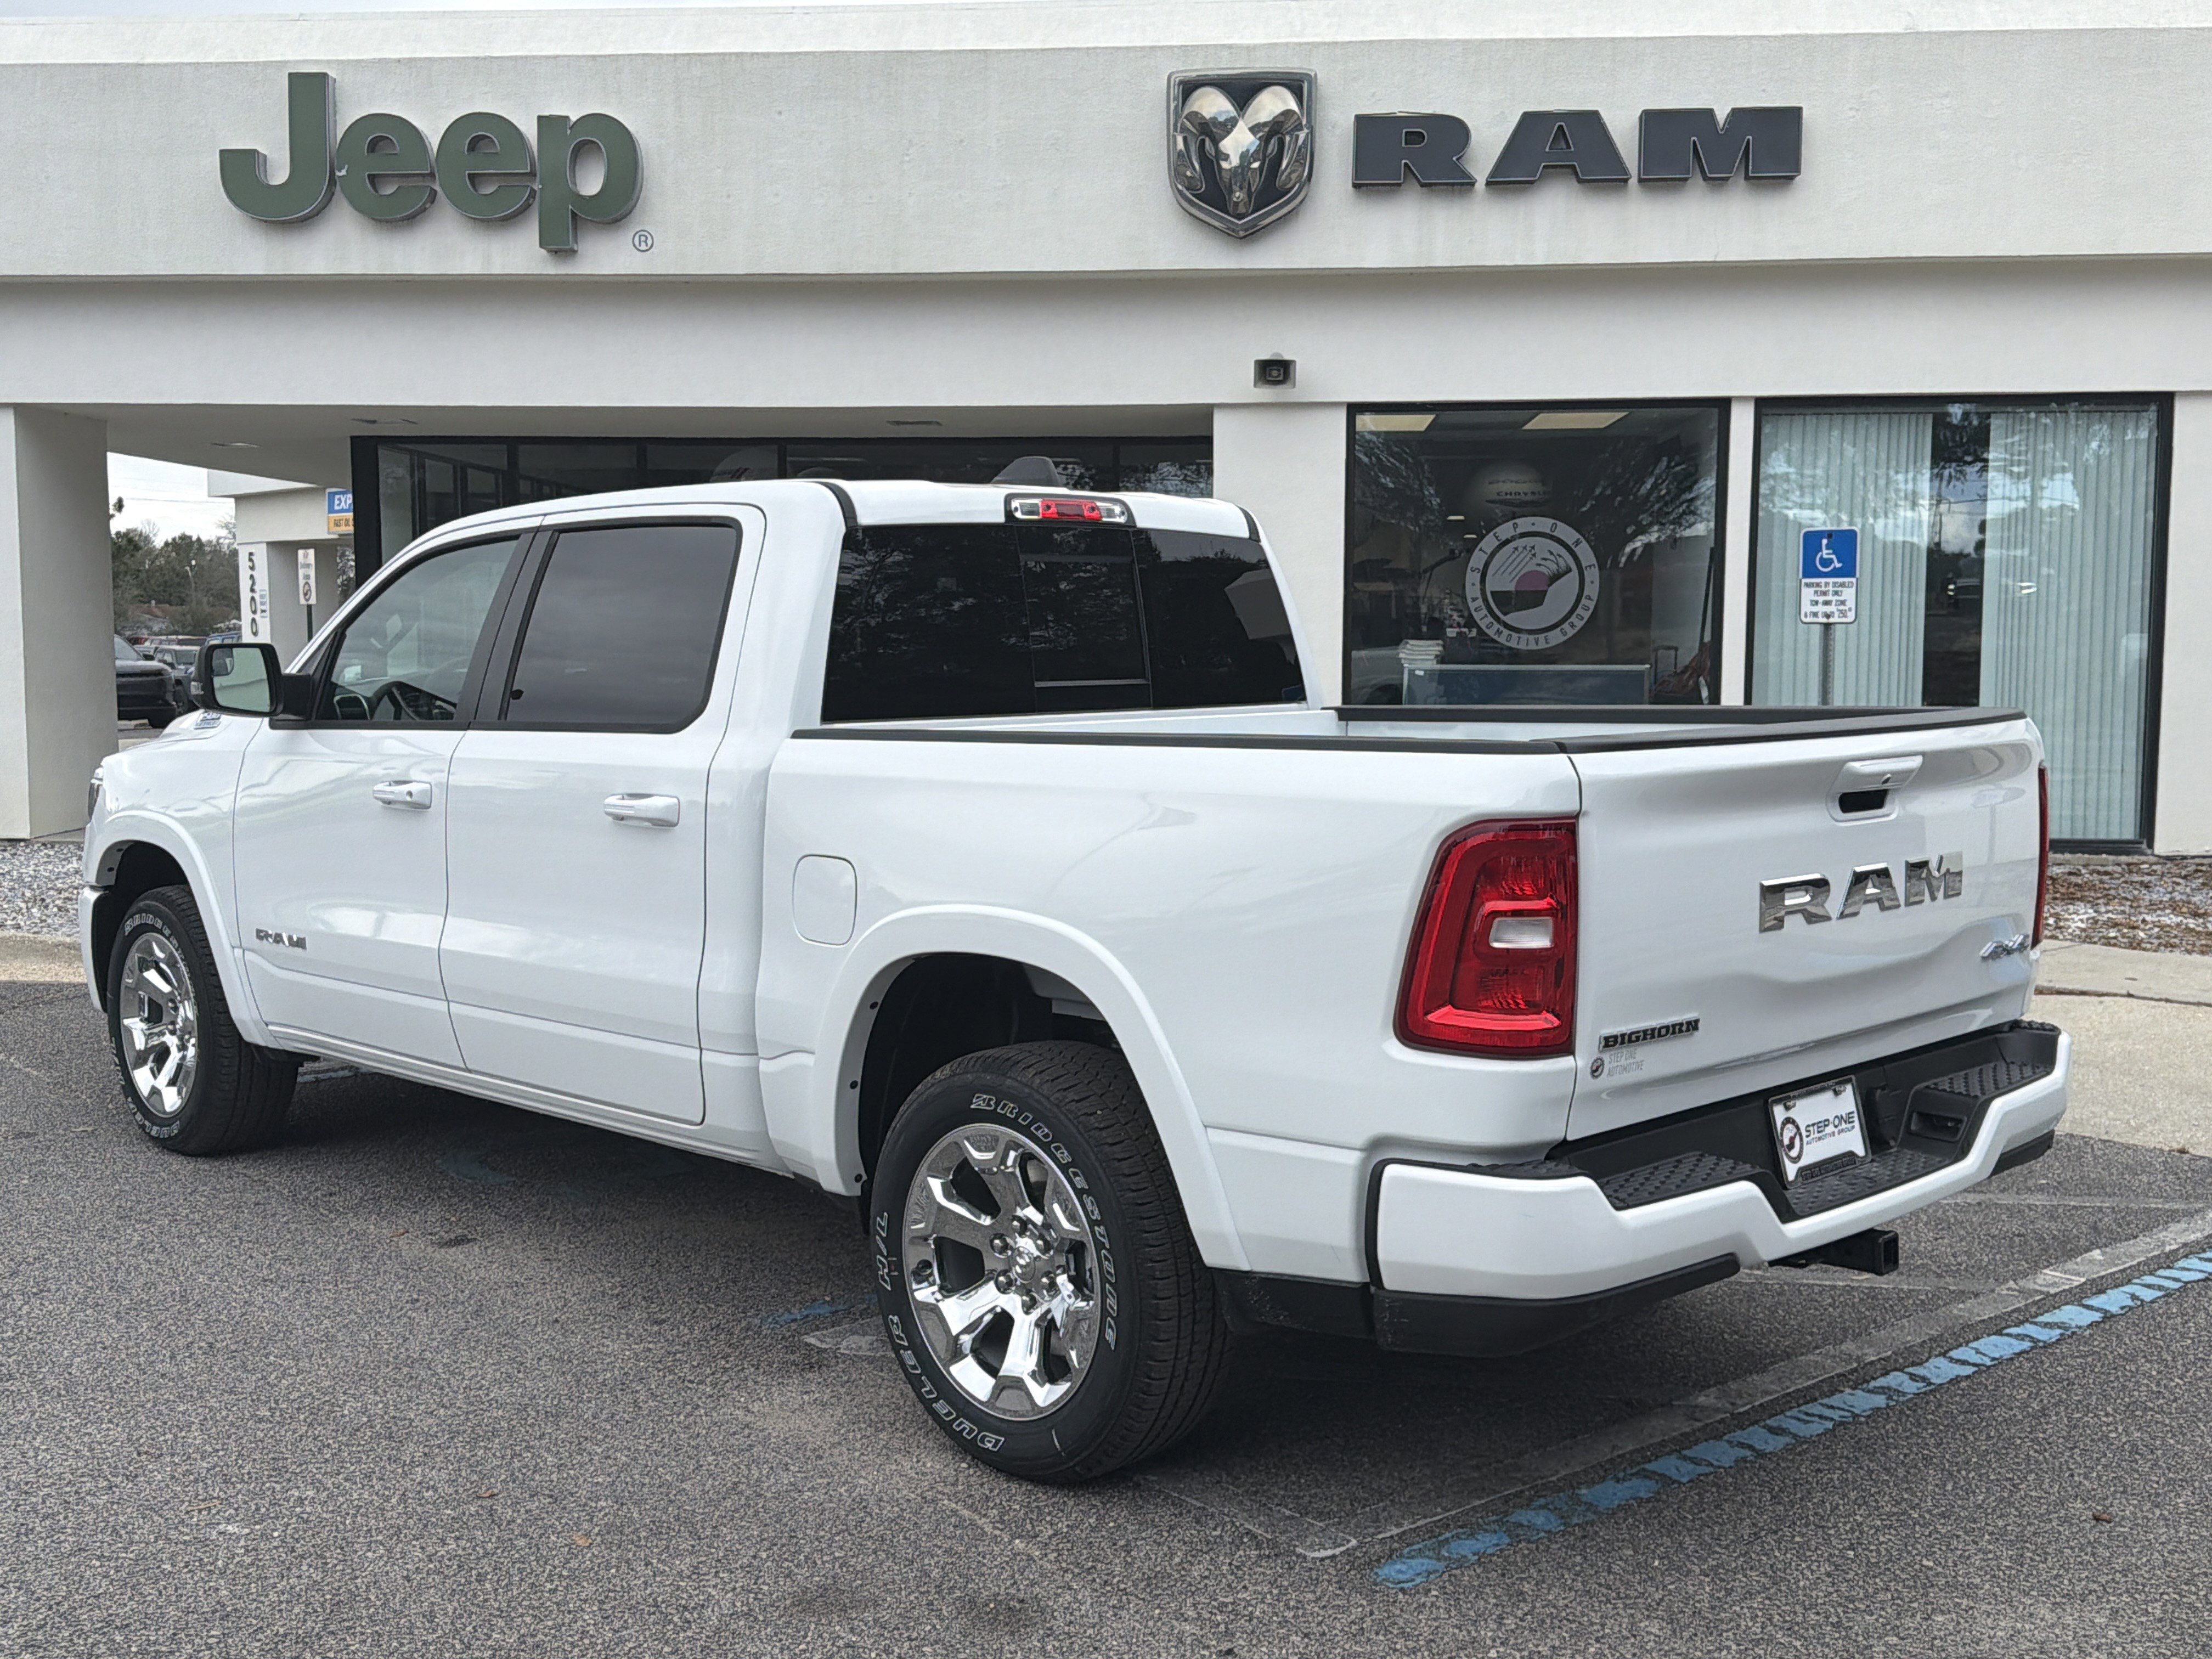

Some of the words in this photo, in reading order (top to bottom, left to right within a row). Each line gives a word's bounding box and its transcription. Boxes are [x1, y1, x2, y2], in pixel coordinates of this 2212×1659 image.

[219, 72, 644, 252] Jeep
[1352, 106, 1803, 188] RAM
[1759, 851, 1963, 933] RAM
[256, 928, 307, 951] RAM
[1600, 1017, 1701, 1050] BIGHORN
[1805, 1130, 1836, 1146] AUTOMOTIVE
[970, 1093, 1118, 1350] BRIDGESTONE
[888, 1314, 1006, 1452] DUELER
